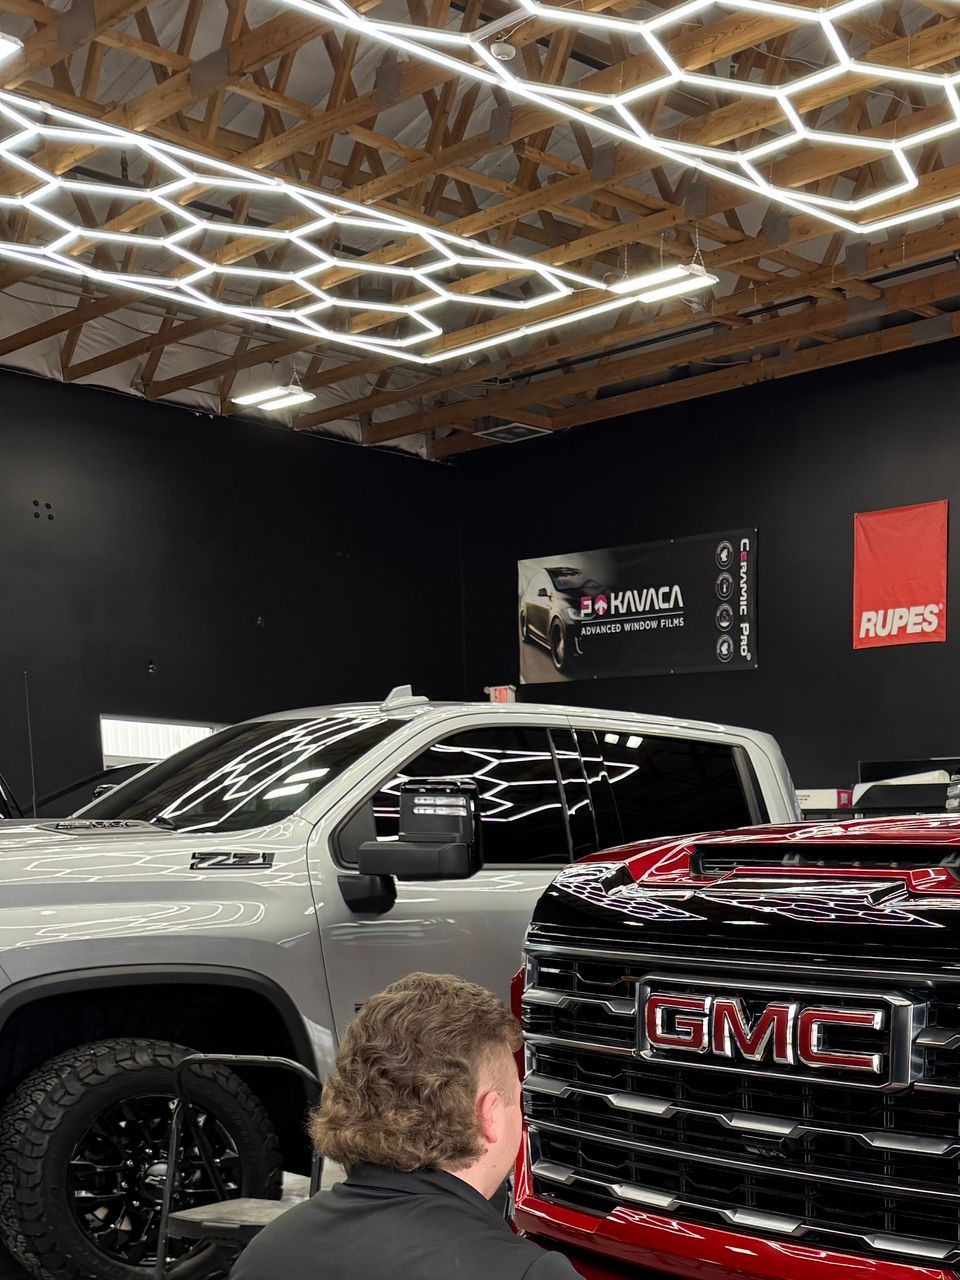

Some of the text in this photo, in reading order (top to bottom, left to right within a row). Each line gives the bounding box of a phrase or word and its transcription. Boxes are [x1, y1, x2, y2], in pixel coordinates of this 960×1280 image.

[739, 538, 750, 616] CERAMIC
[610, 584, 684, 615] KAVACA
[580, 617, 685, 636] ADVANCED WINDOW FILMS
[189, 852, 275, 870] Z71
[645, 992, 884, 1075] GMC
